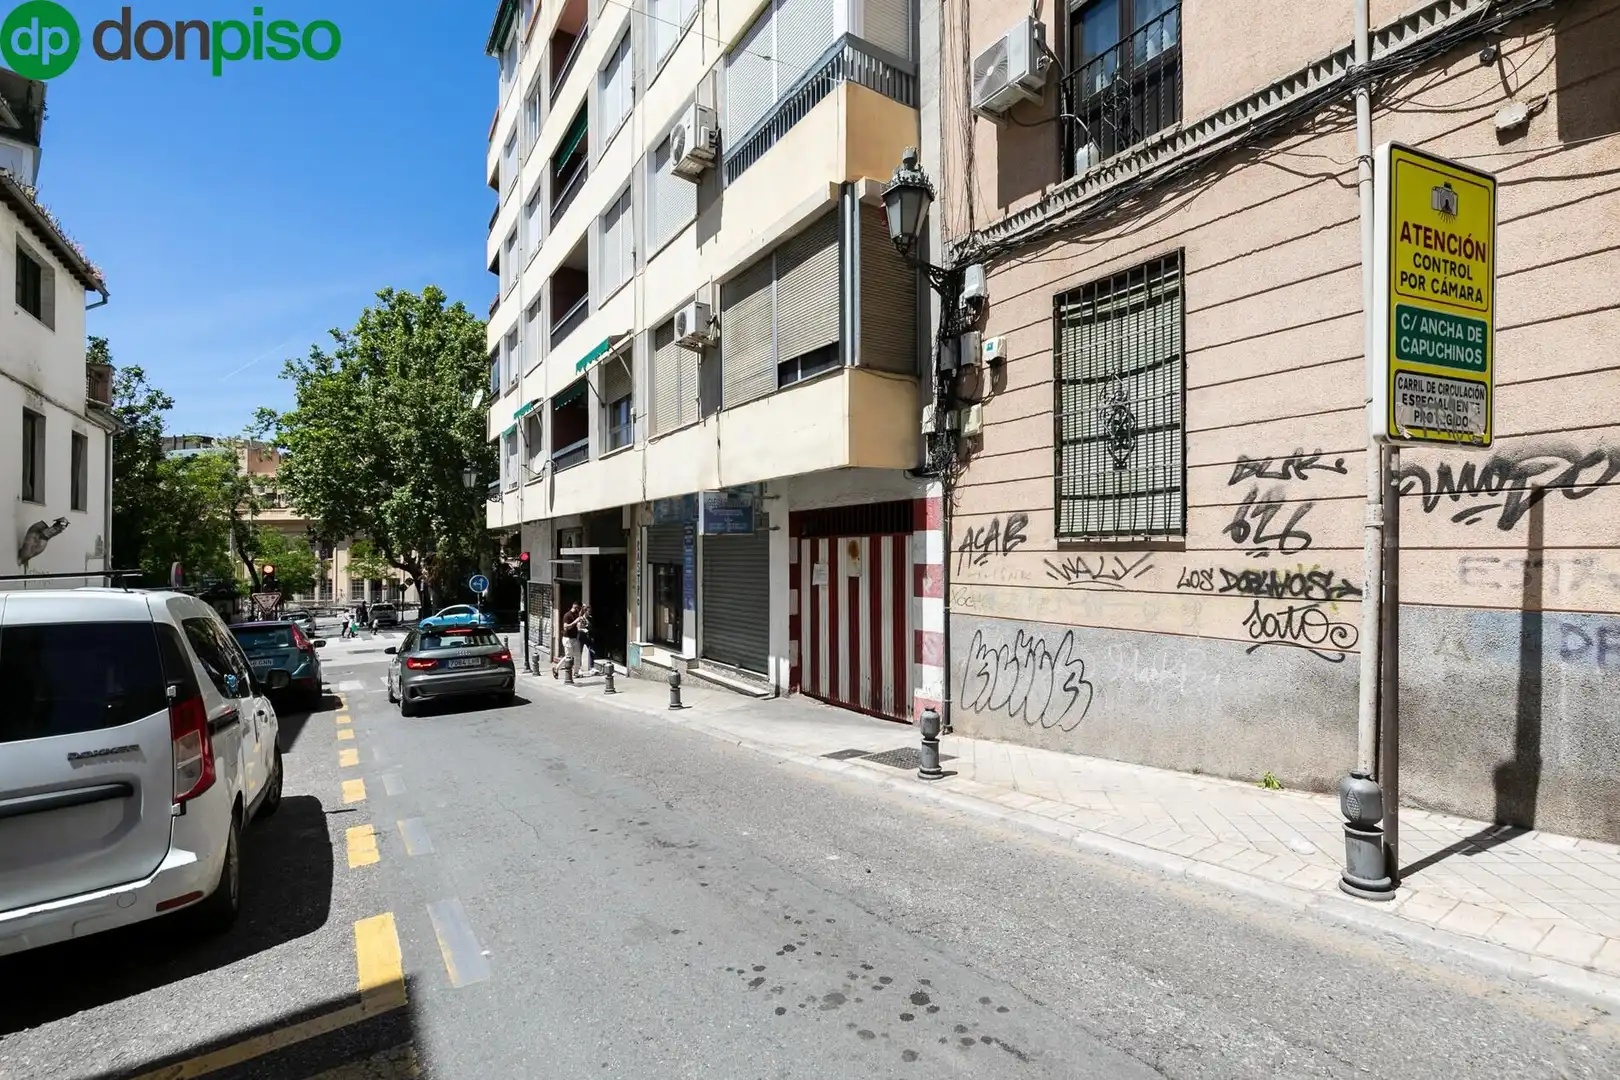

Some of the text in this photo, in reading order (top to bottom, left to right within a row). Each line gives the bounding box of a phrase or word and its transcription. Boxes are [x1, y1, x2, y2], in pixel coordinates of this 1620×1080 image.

[1400, 221, 1486, 263] ATENCIÓN
[1413, 252, 1473, 281] CONTROL
[1400, 271, 1483, 304] POR CÁMARA
[1400, 312, 1483, 343] C/ ANCHA DE
[1400, 335, 1483, 365] CAPUCHINOS
[1397, 377, 1485, 400] CARRIL DE CIRCULACIÓN
[1177, 567, 1213, 591] LOS
